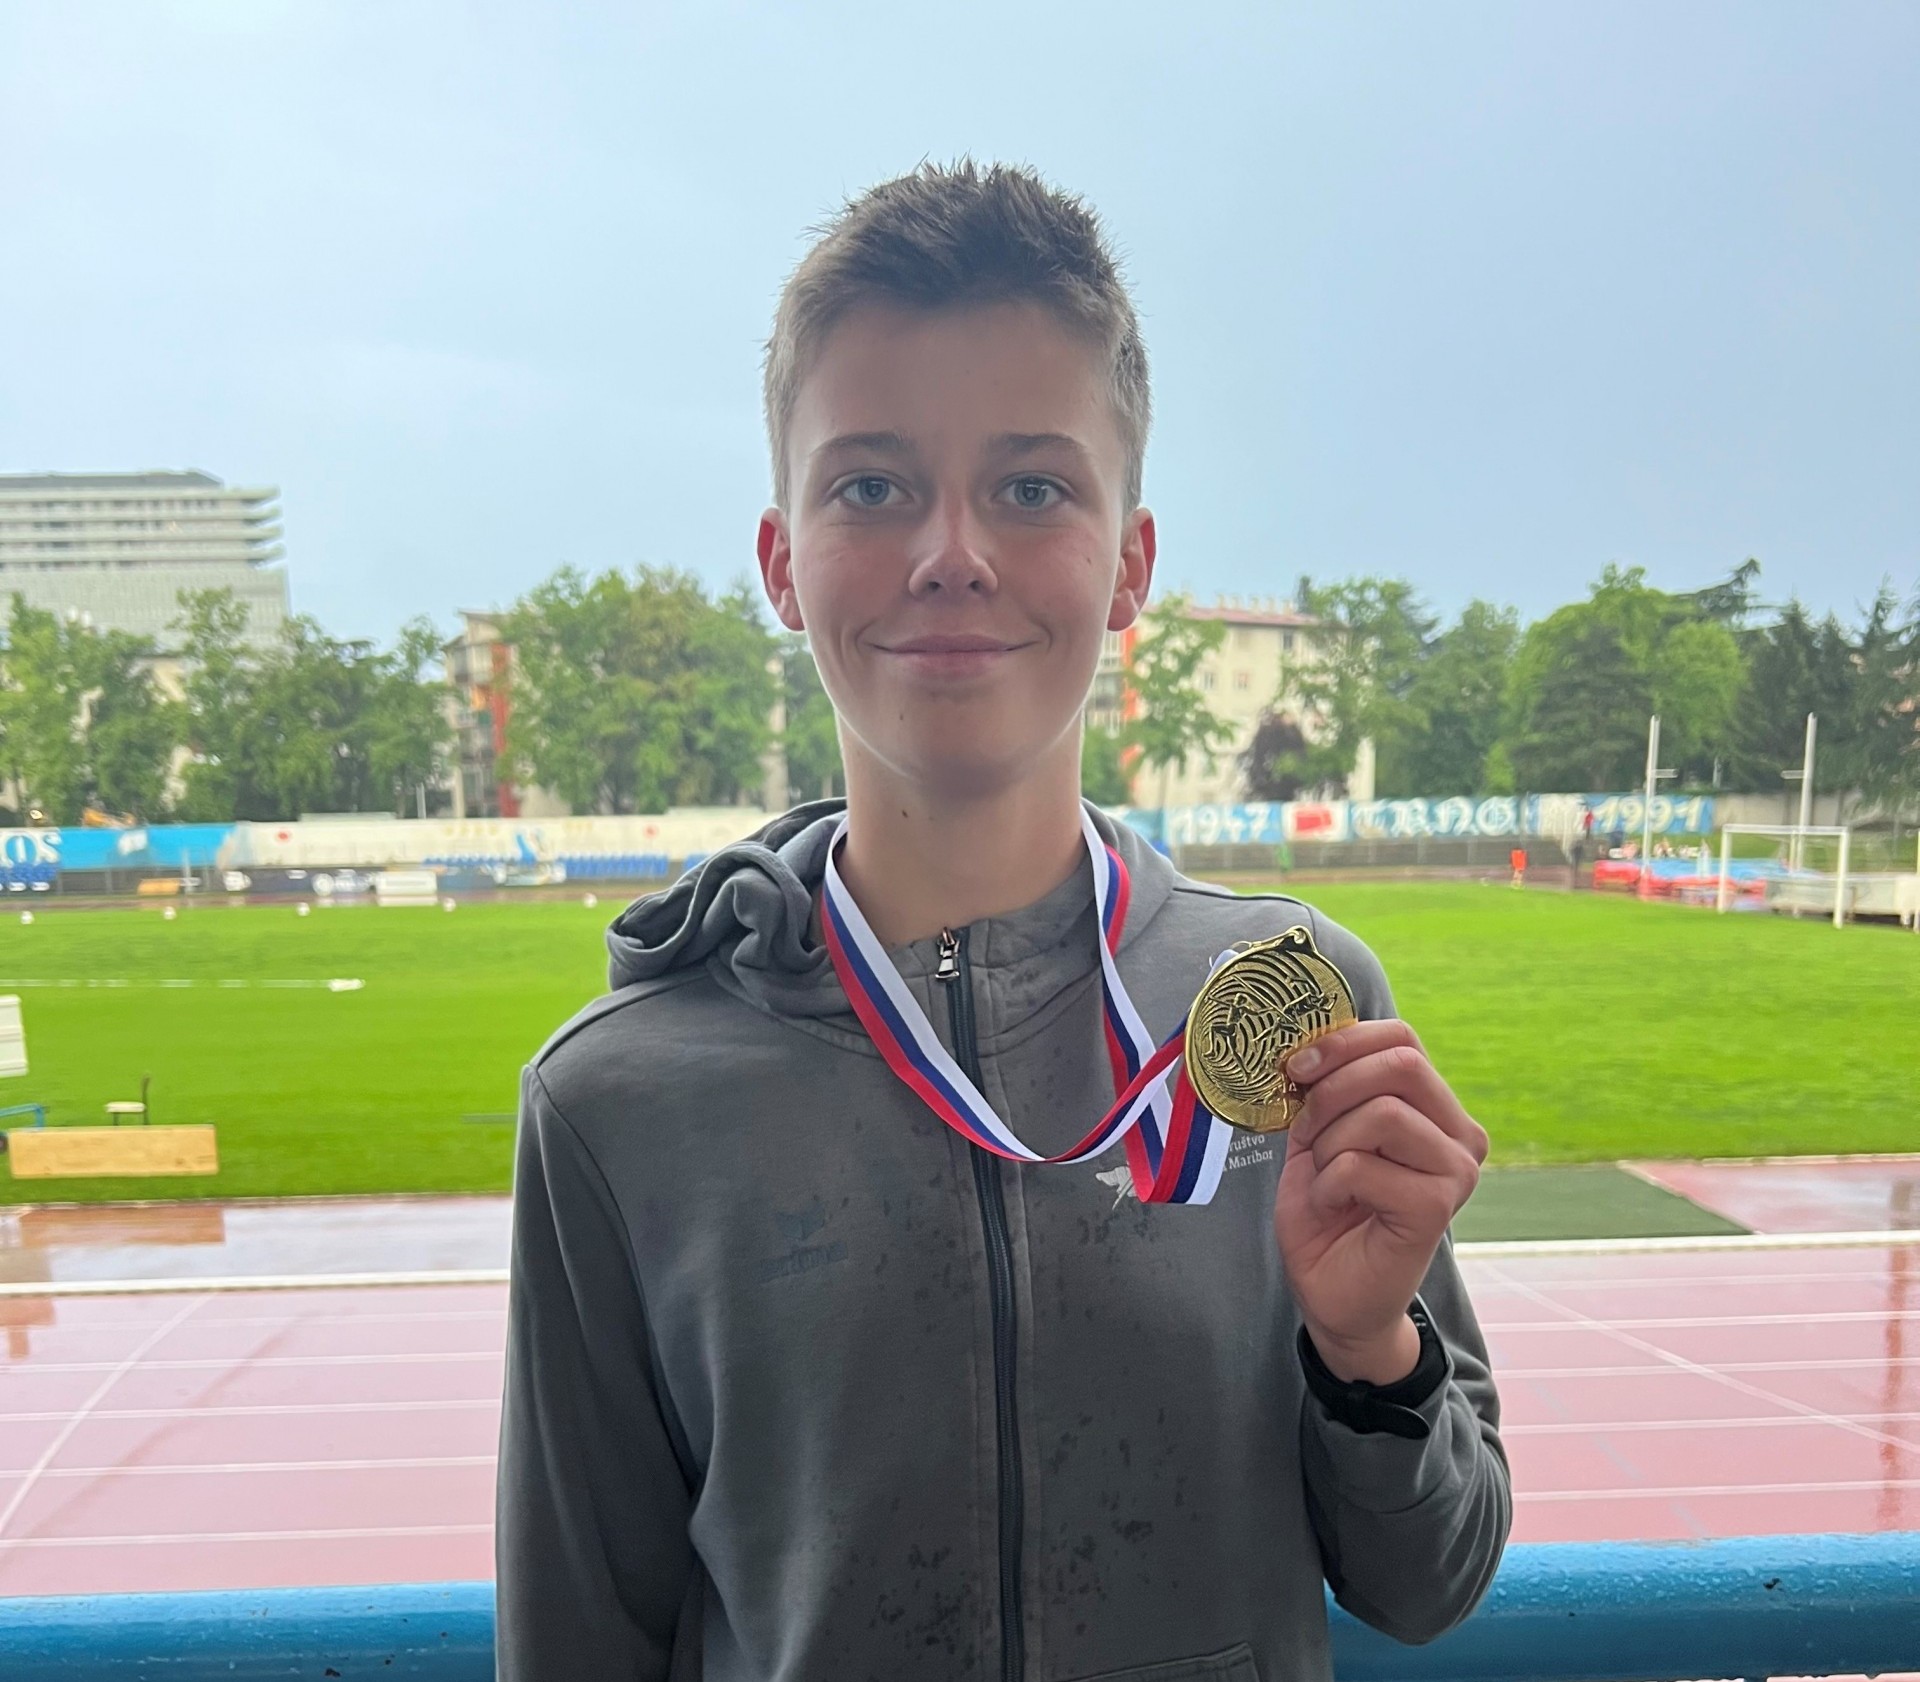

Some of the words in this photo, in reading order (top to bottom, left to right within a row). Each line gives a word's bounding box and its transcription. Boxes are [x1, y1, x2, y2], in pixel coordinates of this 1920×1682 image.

[1168, 801, 1272, 846] 1947
[1590, 795, 1704, 834] 1991
[1229, 1134, 1265, 1152] ruštvo
